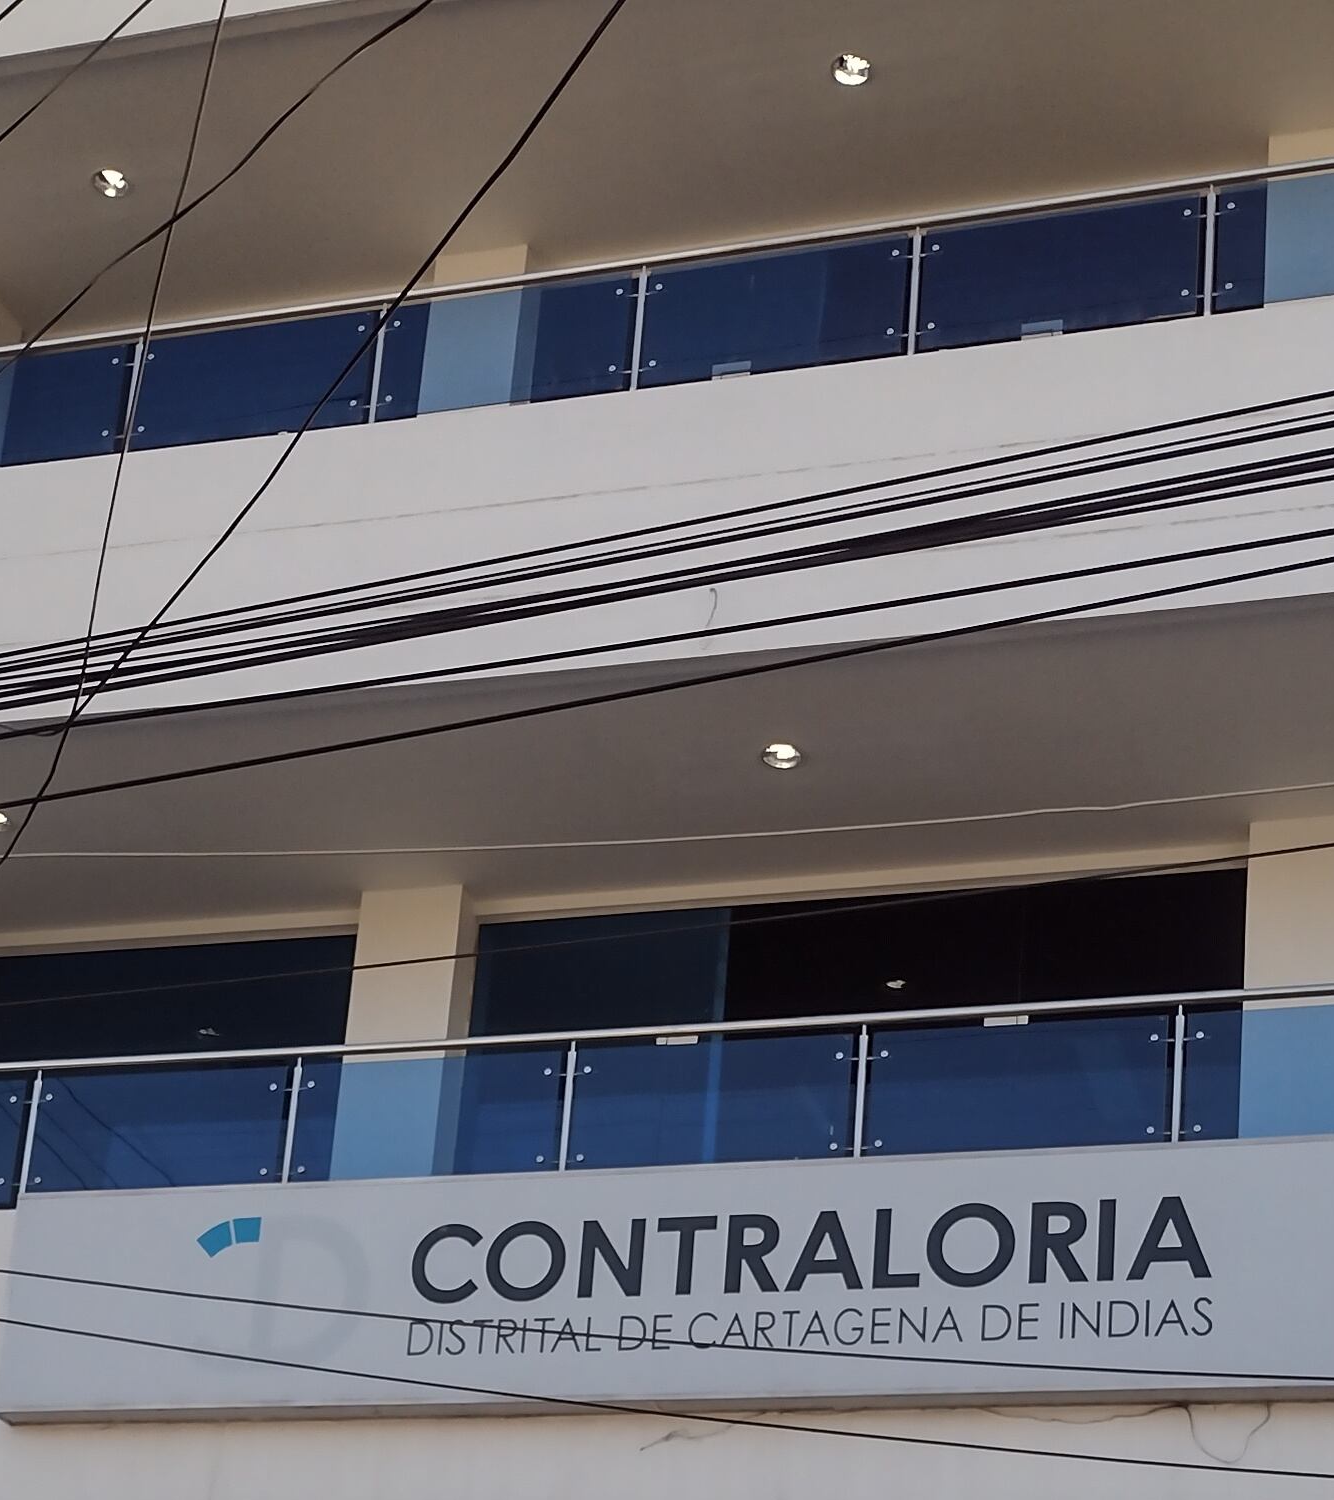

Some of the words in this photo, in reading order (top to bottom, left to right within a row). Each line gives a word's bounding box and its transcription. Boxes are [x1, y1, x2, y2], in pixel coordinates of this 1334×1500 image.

[410, 1195, 1213, 1305] CONTRALORIA
[406, 1316, 602, 1356] DISTRITAL
[617, 1313, 674, 1353] DE
[687, 1305, 964, 1350] CARTAGENA
[980, 1302, 1040, 1342] DE
[1058, 1296, 1214, 1340] INDIAS
